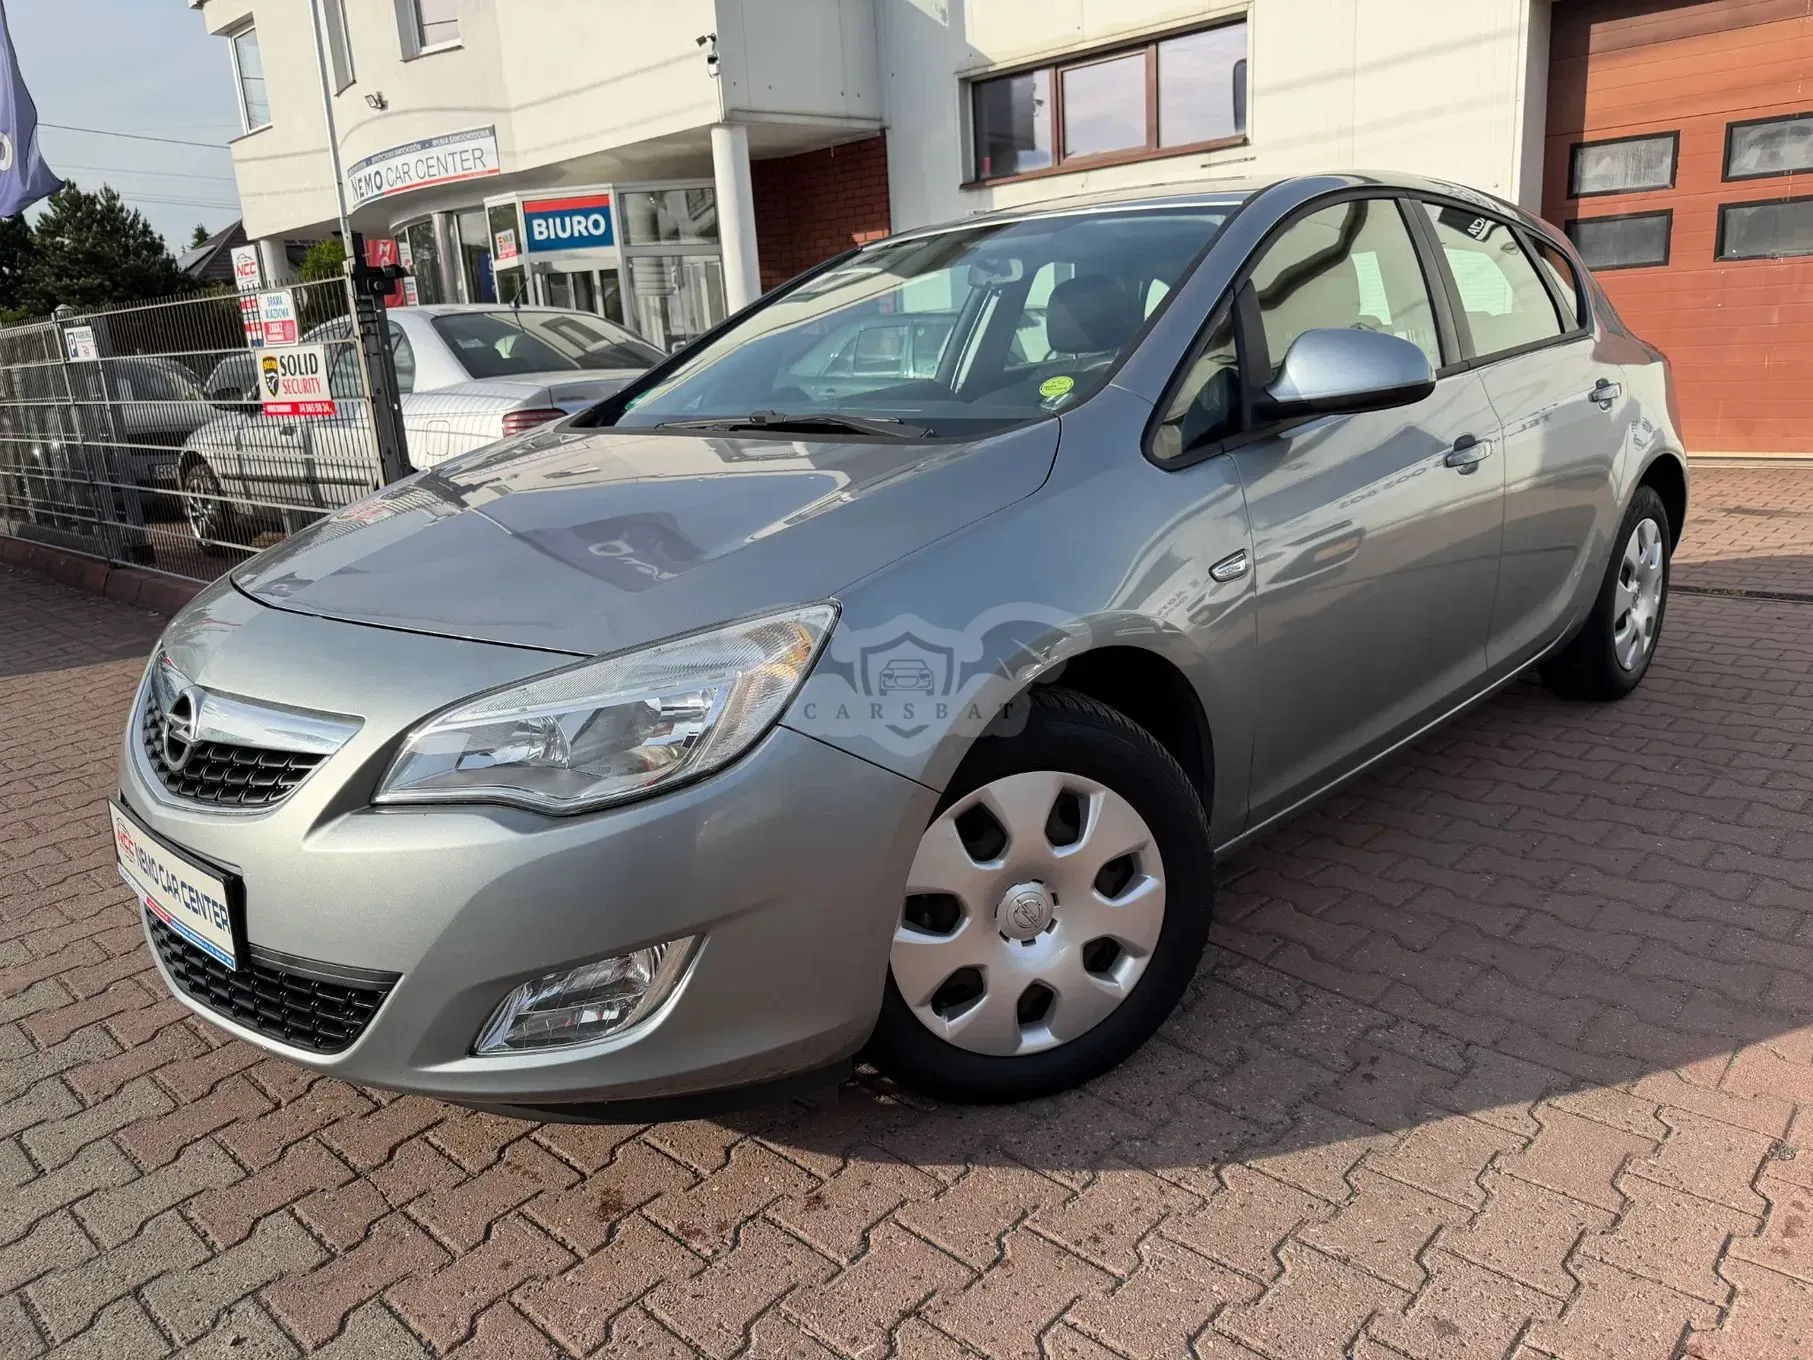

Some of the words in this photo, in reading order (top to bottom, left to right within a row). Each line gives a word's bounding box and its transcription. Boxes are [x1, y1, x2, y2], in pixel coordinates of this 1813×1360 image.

[351, 169, 383, 203] NEMO
[386, 162, 413, 187] CAR
[415, 147, 486, 180] CENTER
[532, 213, 606, 241] BIURO
[236, 261, 257, 277] NCC
[280, 353, 319, 377] SOLID
[282, 378, 321, 395] SECURITY
[134, 842, 160, 886] NEMO
[159, 864, 182, 903] CAR
[180, 880, 231, 935] CENTER
